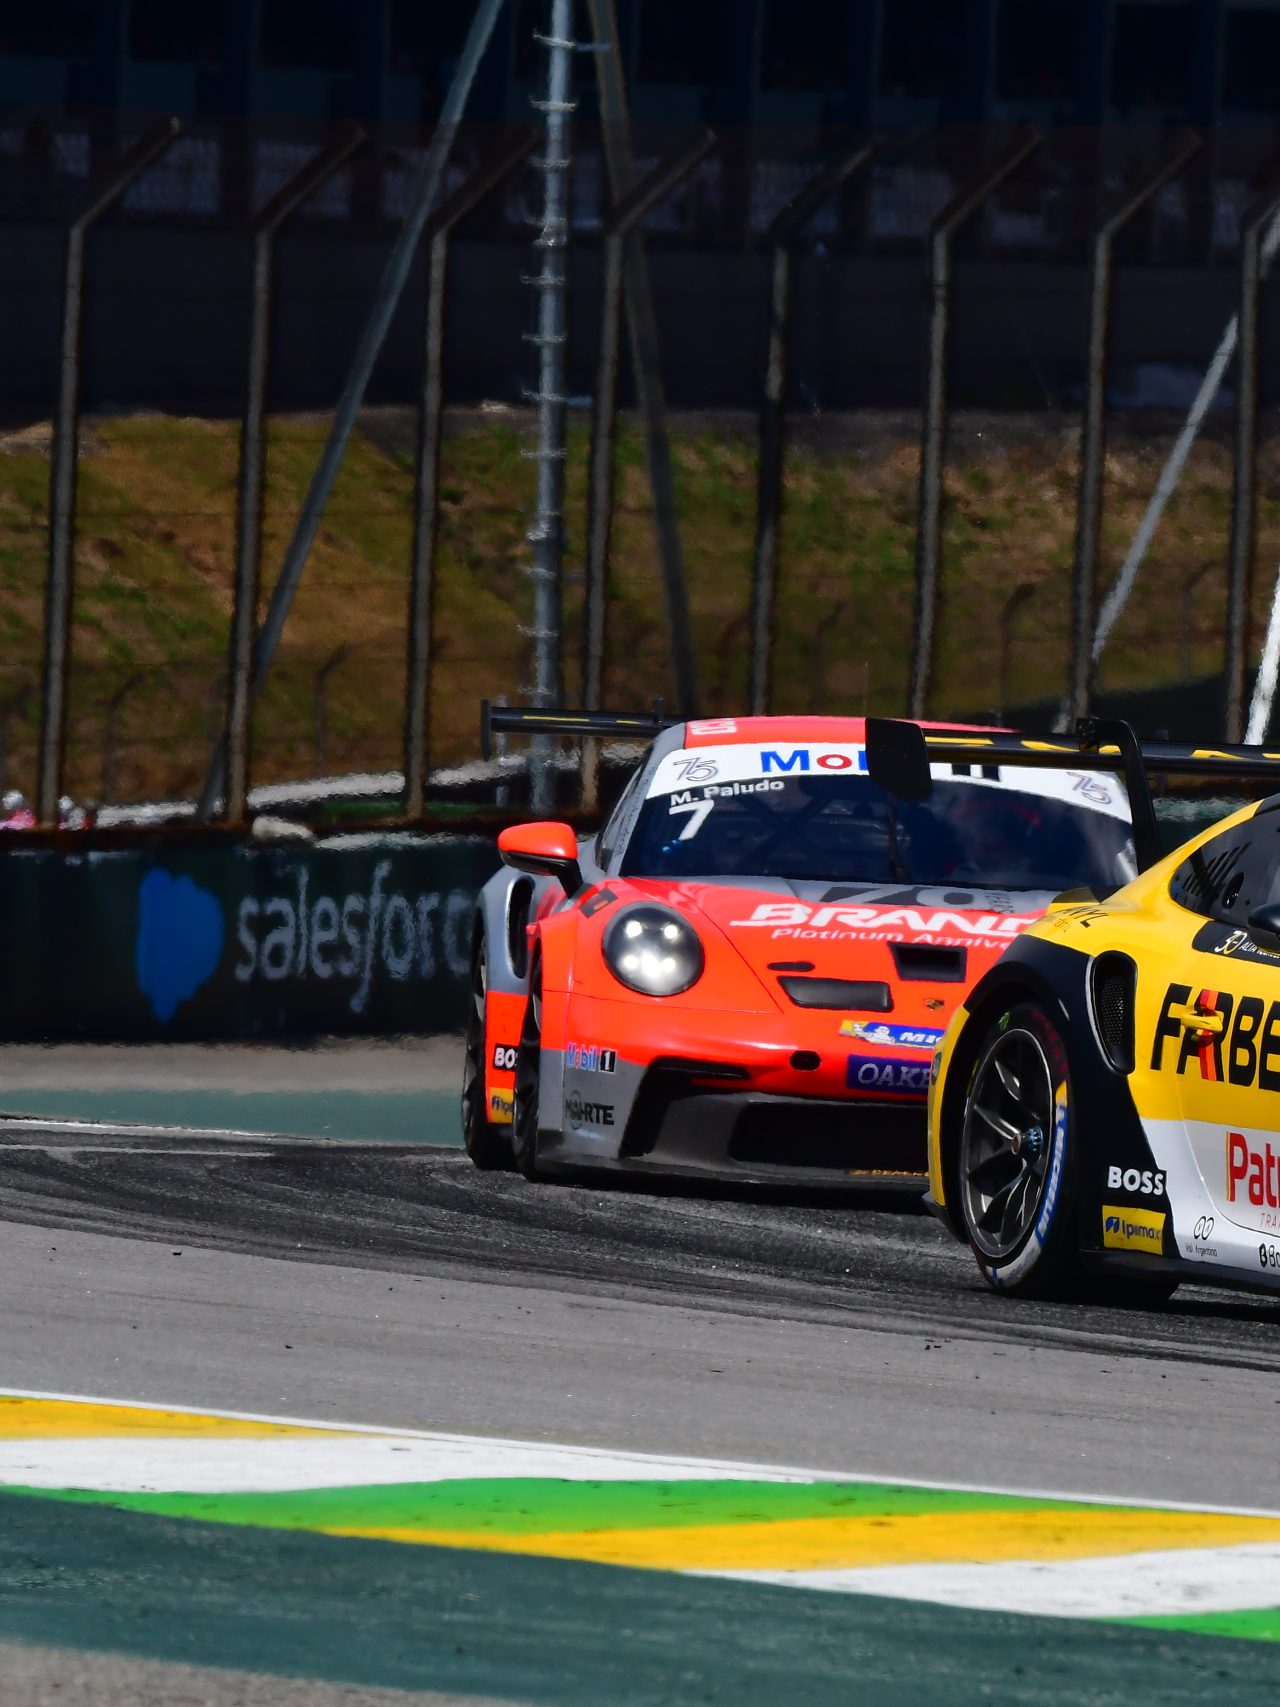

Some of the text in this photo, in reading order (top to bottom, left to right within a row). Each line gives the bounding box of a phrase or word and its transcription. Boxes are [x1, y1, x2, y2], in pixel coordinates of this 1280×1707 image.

[670, 778, 785, 808] M. Paludo
[668, 799, 714, 841] 7
[771, 927, 904, 943] Platinum
[566, 1042, 597, 1072] Mobil
[1107, 1166, 1164, 1196] BOSS
